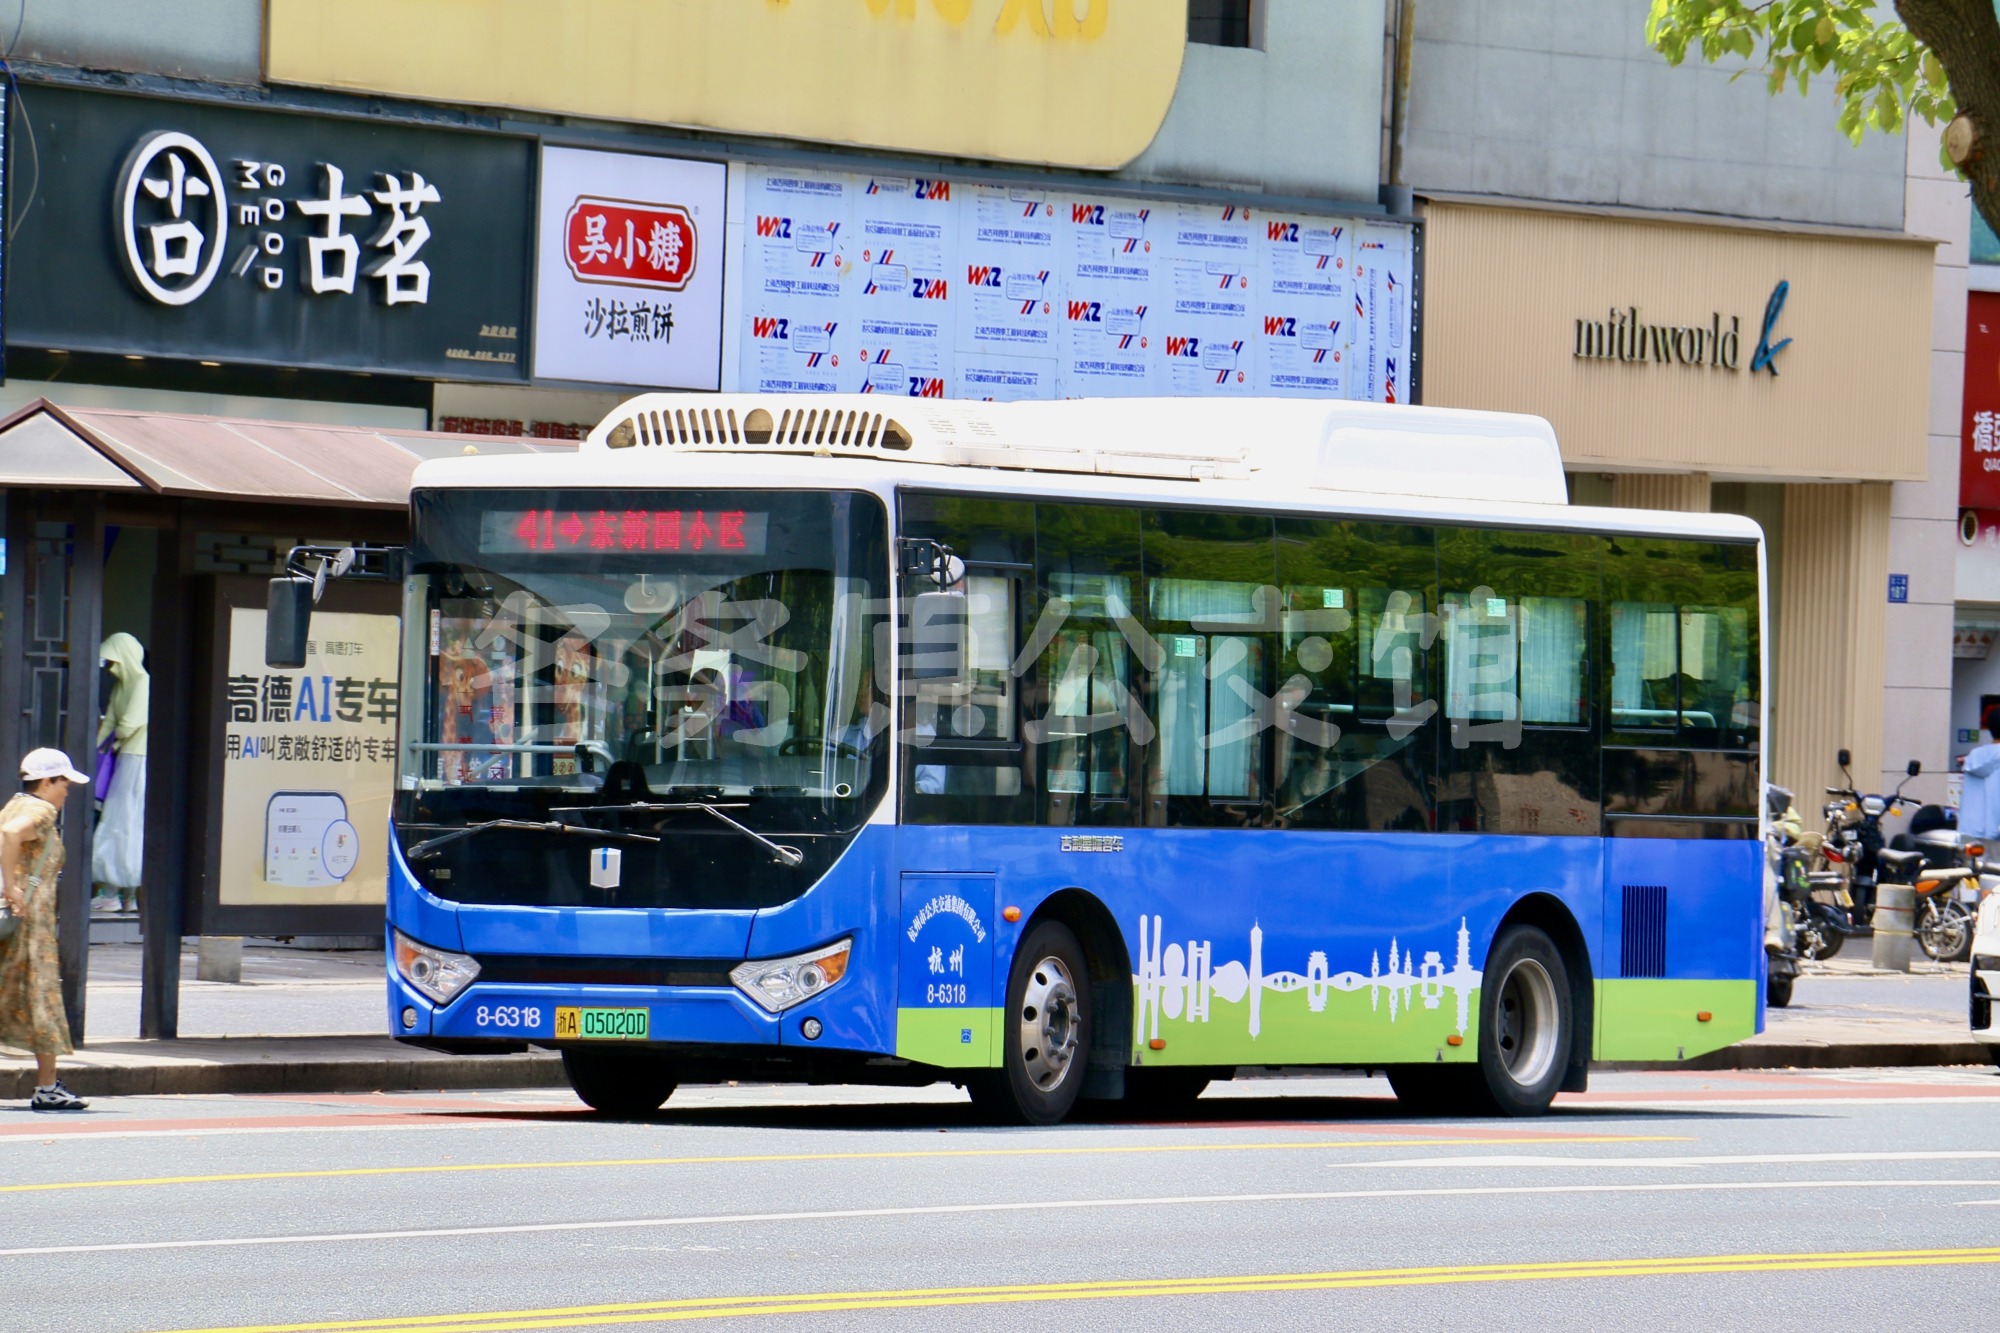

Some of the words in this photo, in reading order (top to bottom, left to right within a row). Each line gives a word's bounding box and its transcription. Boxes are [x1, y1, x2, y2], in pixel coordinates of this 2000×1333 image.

[240, 160, 261, 226] ME
[265, 163, 286, 289] GOOD
[298, 163, 441, 304] 古茗
[578, 214, 684, 275] 吴小糖
[584, 297, 674, 344] 沙拉煎饼
[1574, 306, 1742, 371] mithworld
[519, 510, 555, 549] 41
[589, 510, 746, 550] 东新园小区
[227, 674, 398, 724] 高德AI专车
[225, 734, 396, 763] 用AI叫宽敞舒适的专车
[907, 895, 987, 943] 杭州市公共交通集团有限公司
[928, 944, 964, 978] 杭州
[476, 1006, 541, 1028] 8-6318
[927, 984, 966, 1004] 8-6318
